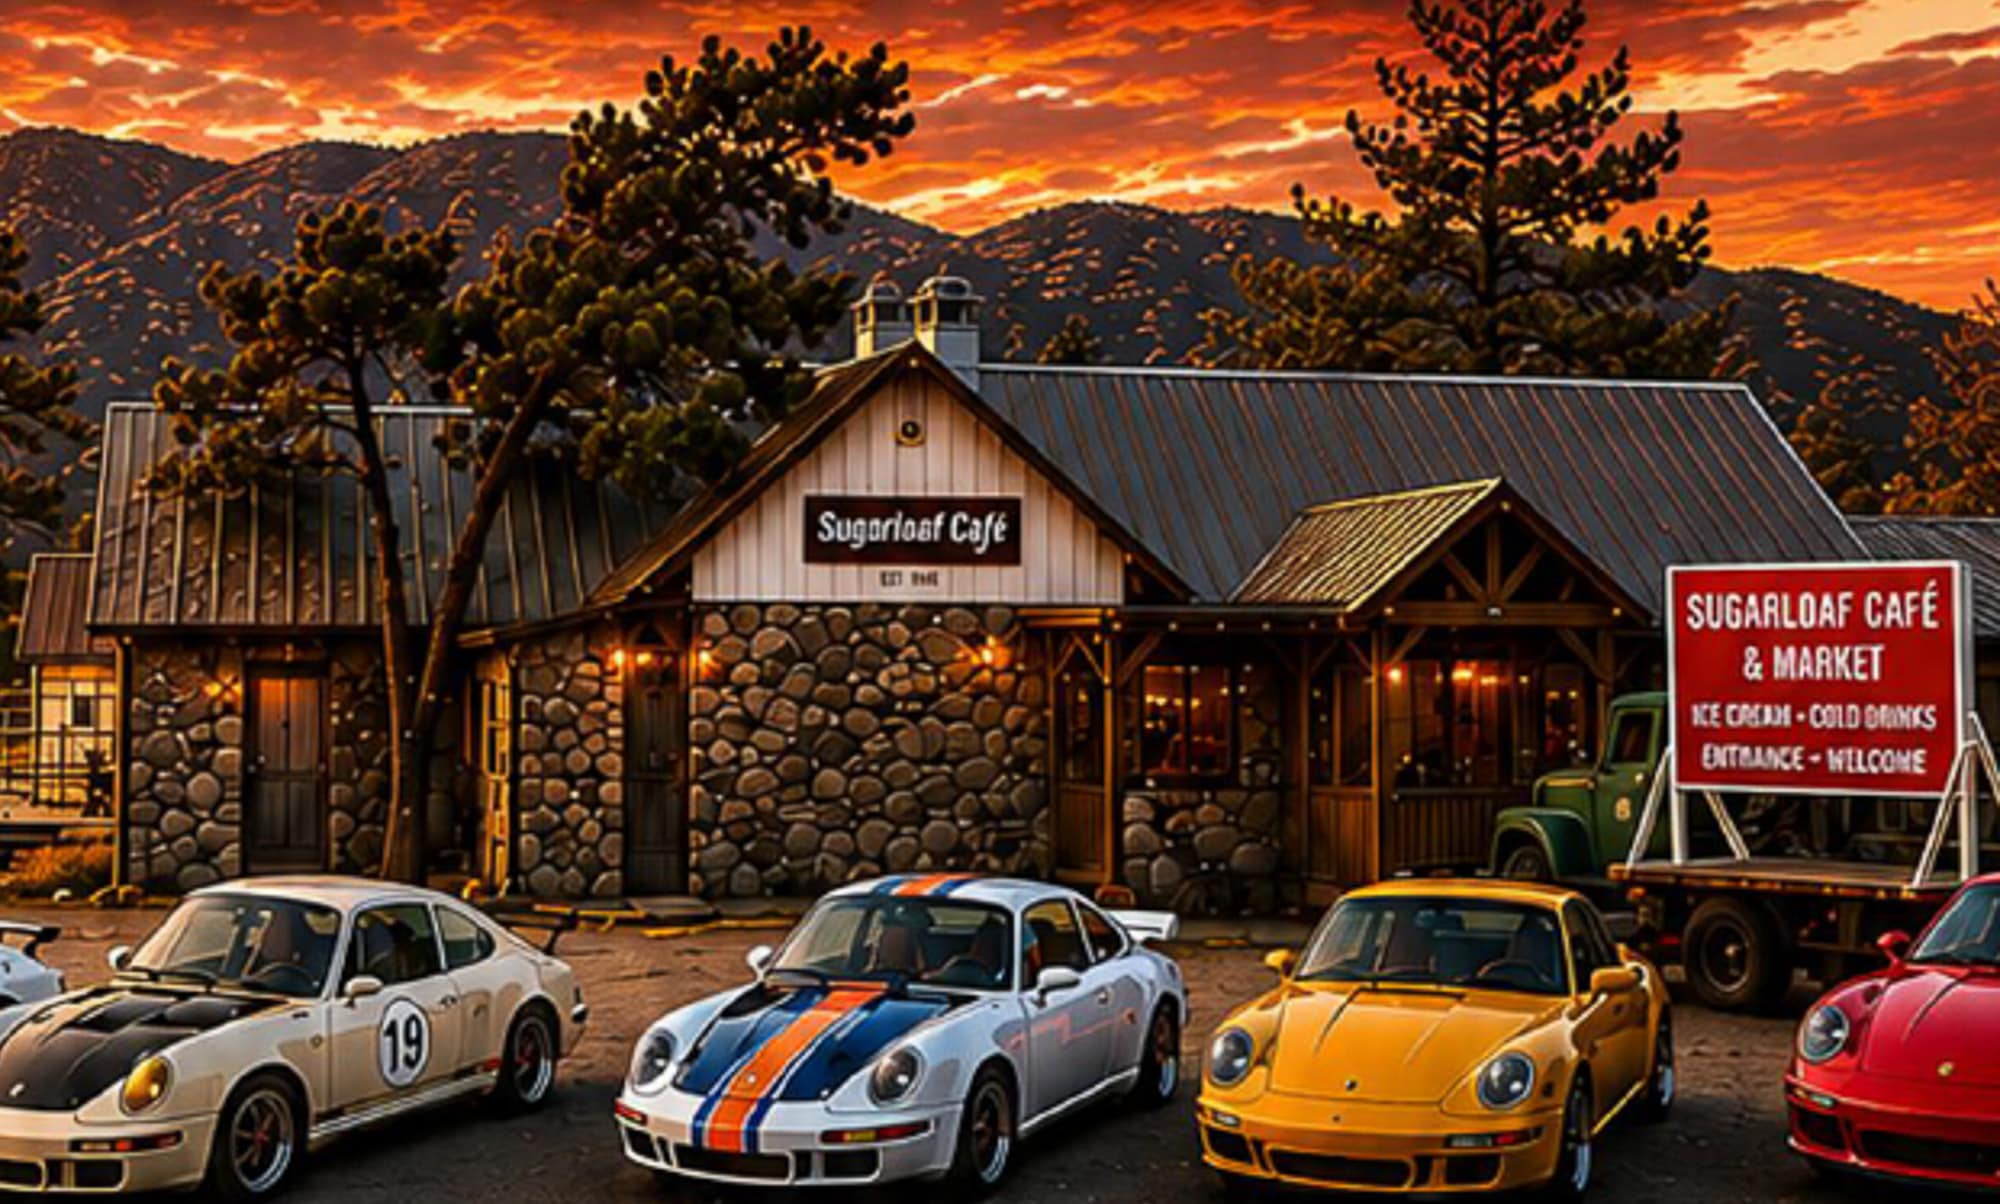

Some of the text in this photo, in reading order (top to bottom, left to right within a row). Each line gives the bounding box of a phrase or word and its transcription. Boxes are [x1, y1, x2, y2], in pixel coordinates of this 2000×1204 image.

[817, 510, 1008, 555] Sugarloaf Café
[1686, 580, 1940, 631] SUGARLOAF CAFÉ
[1742, 643, 1886, 681] & MARKET
[1691, 702, 1720, 727] ICE
[1809, 704, 1858, 729] COLD
[1702, 743, 1805, 772] ENTRANCE
[1826, 748, 1928, 775] WELCOME
[383, 1014, 423, 1074] 19
